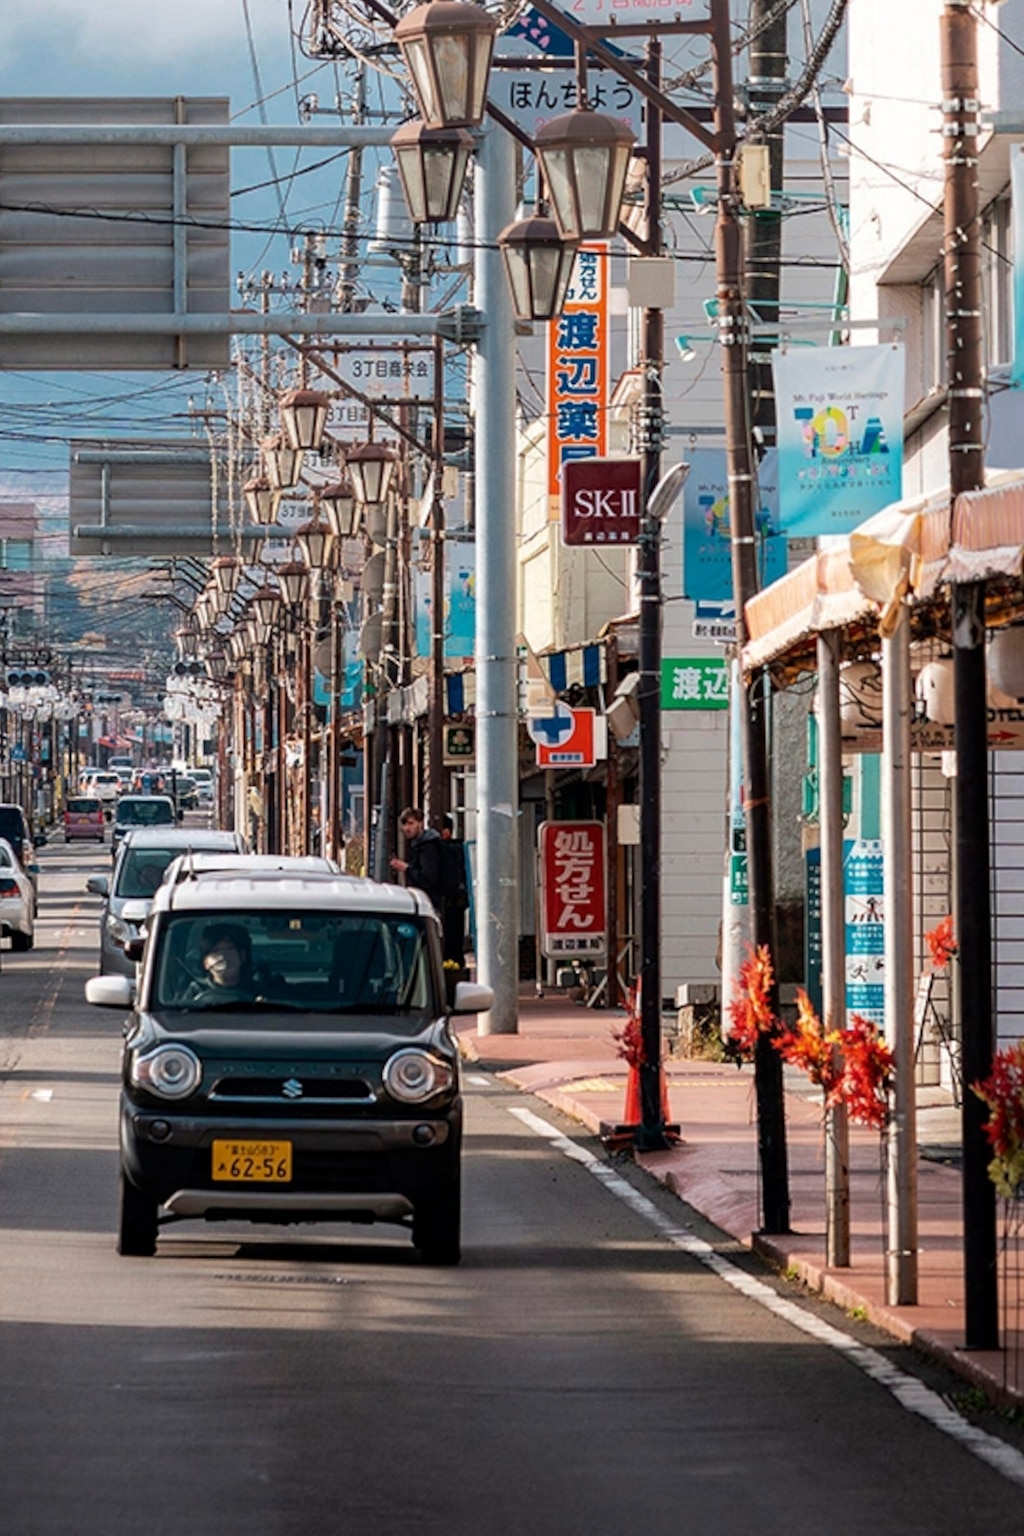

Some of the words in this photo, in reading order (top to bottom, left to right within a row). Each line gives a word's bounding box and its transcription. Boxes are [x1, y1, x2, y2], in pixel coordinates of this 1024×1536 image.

[557, 312, 598, 463] 渡辺薬
[672, 667, 728, 701] 渡辺
[555, 830, 594, 929] 処方せん
[230, 1158, 287, 1178] 62-56
